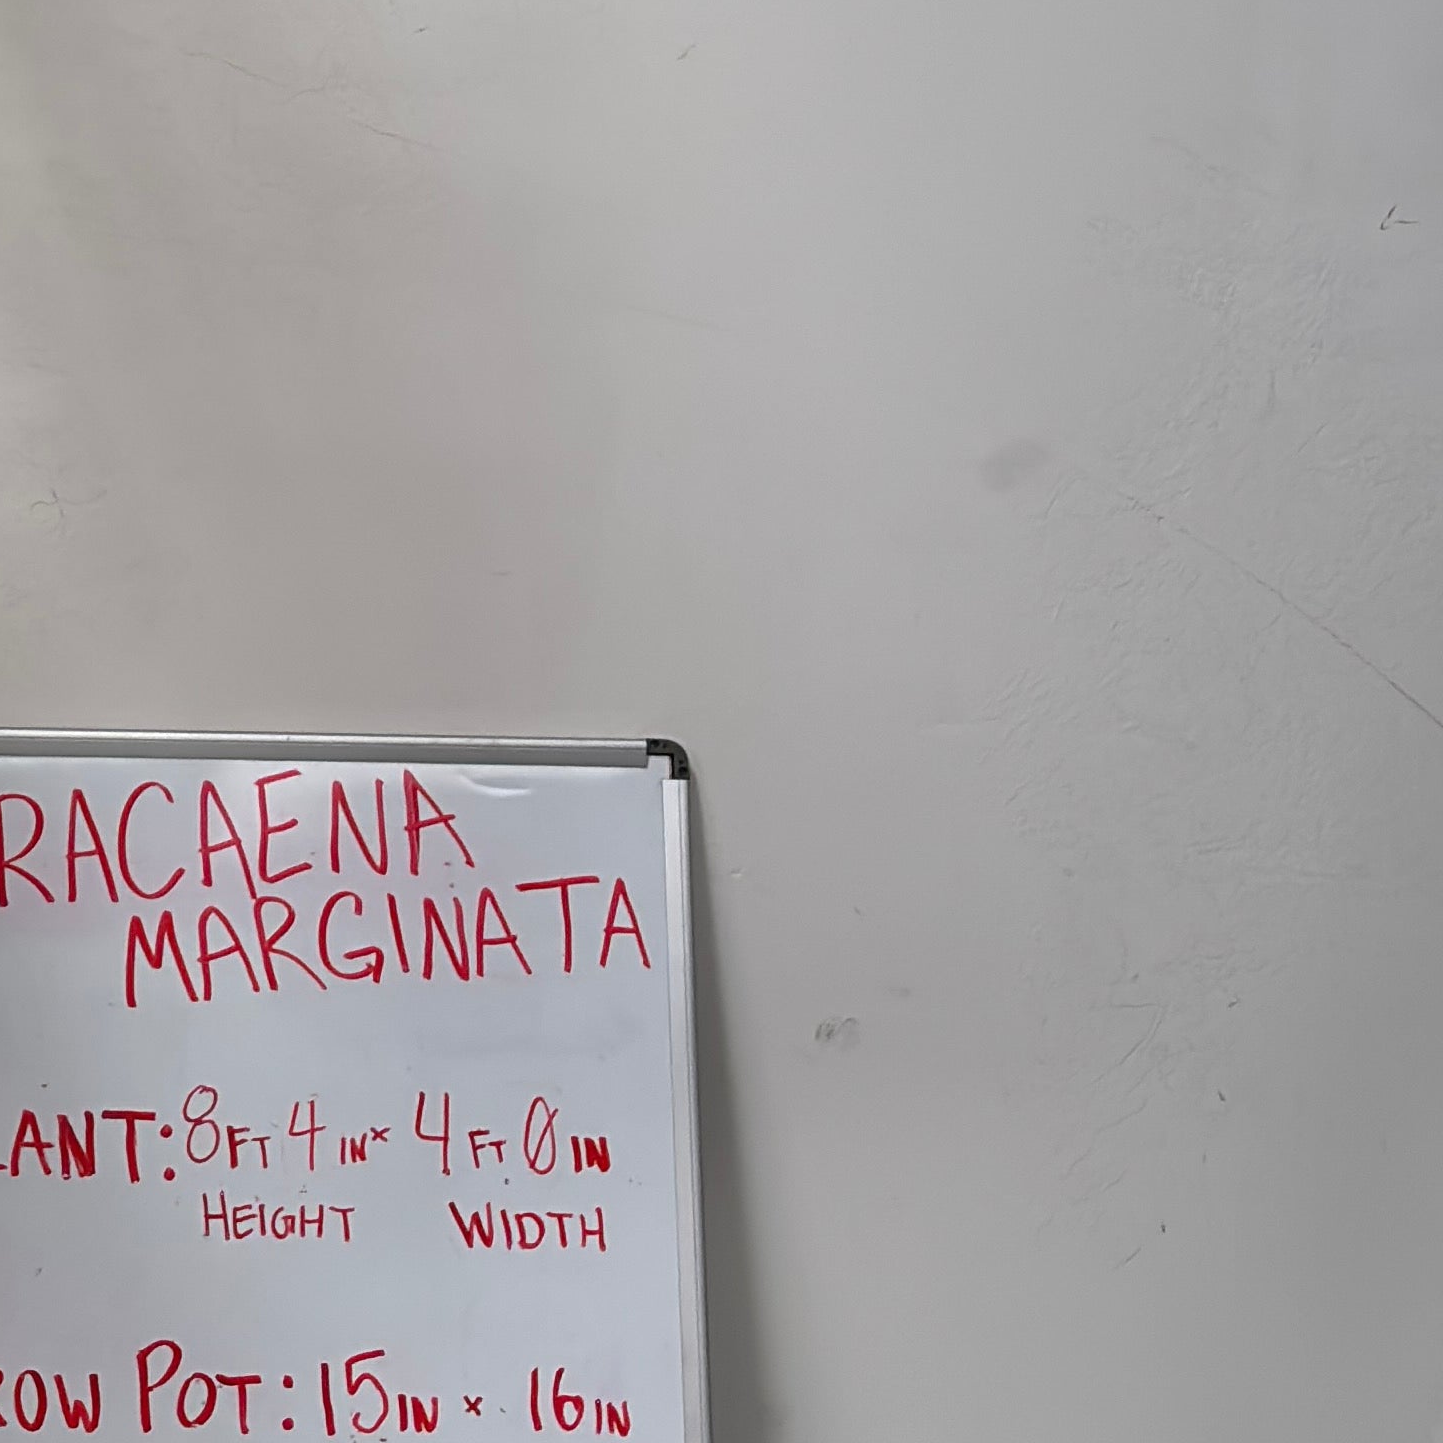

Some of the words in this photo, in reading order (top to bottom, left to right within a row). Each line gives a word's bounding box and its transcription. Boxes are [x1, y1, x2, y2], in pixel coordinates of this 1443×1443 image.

[125, 875, 652, 1009] MARGINATA
[202, 1190, 357, 1243] HEIGHT
[448, 1201, 608, 1252] WIDTH
